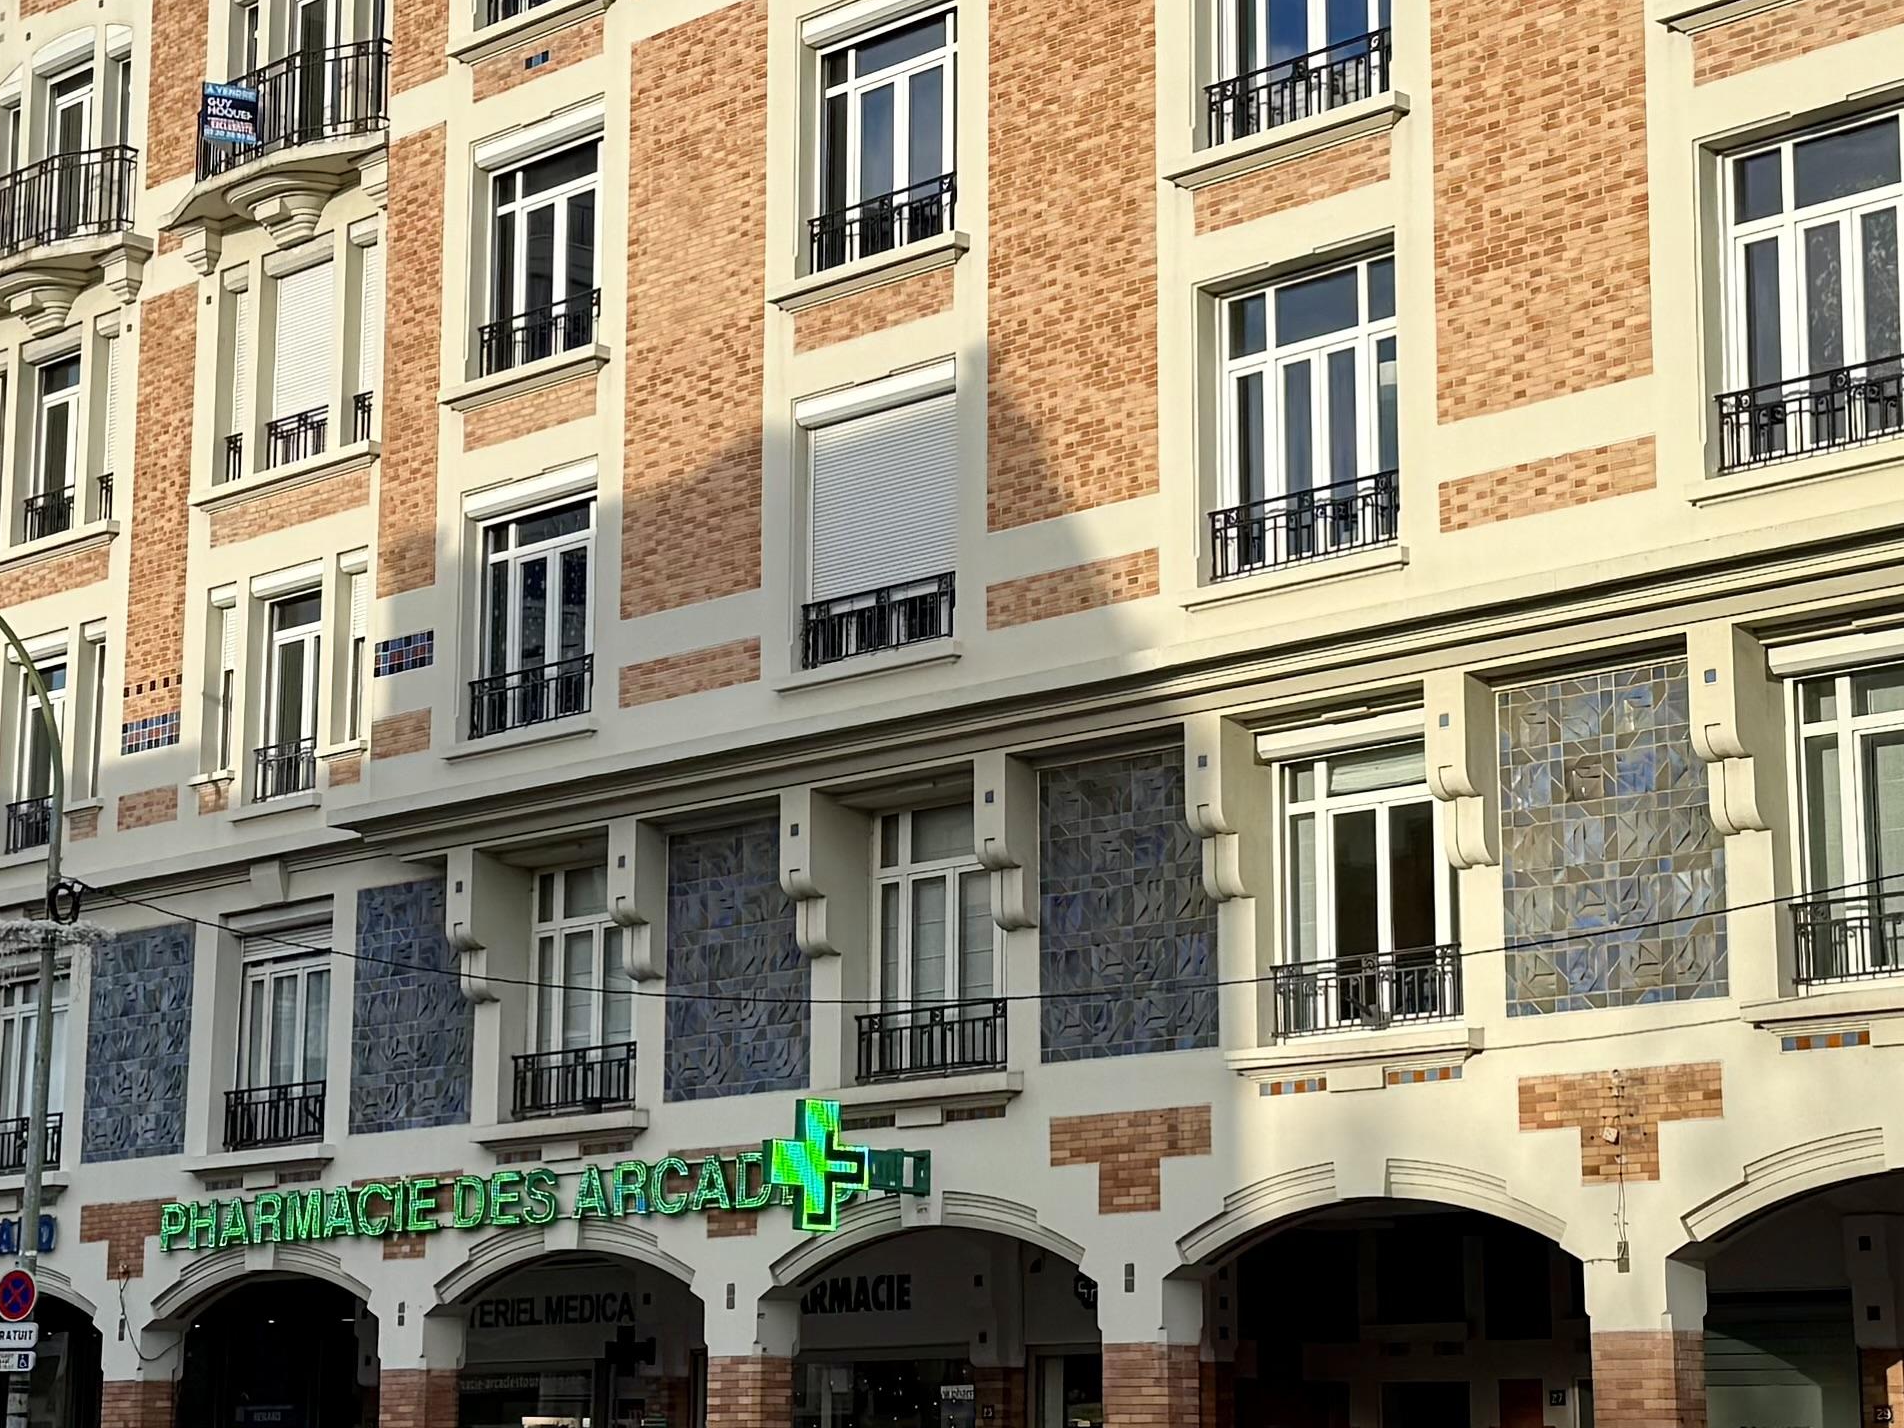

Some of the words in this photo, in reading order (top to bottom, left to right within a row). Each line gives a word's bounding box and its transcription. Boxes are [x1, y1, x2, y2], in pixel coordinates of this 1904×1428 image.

[207, 97, 233, 107] GUY
[159, 1177, 440, 1252] PHARMACIE
[452, 1169, 558, 1230] DES
[572, 1151, 858, 1220] ARCAD
[1551, 1390, 1566, 1405] 27
[1876, 1407, 1892, 1420] 29
